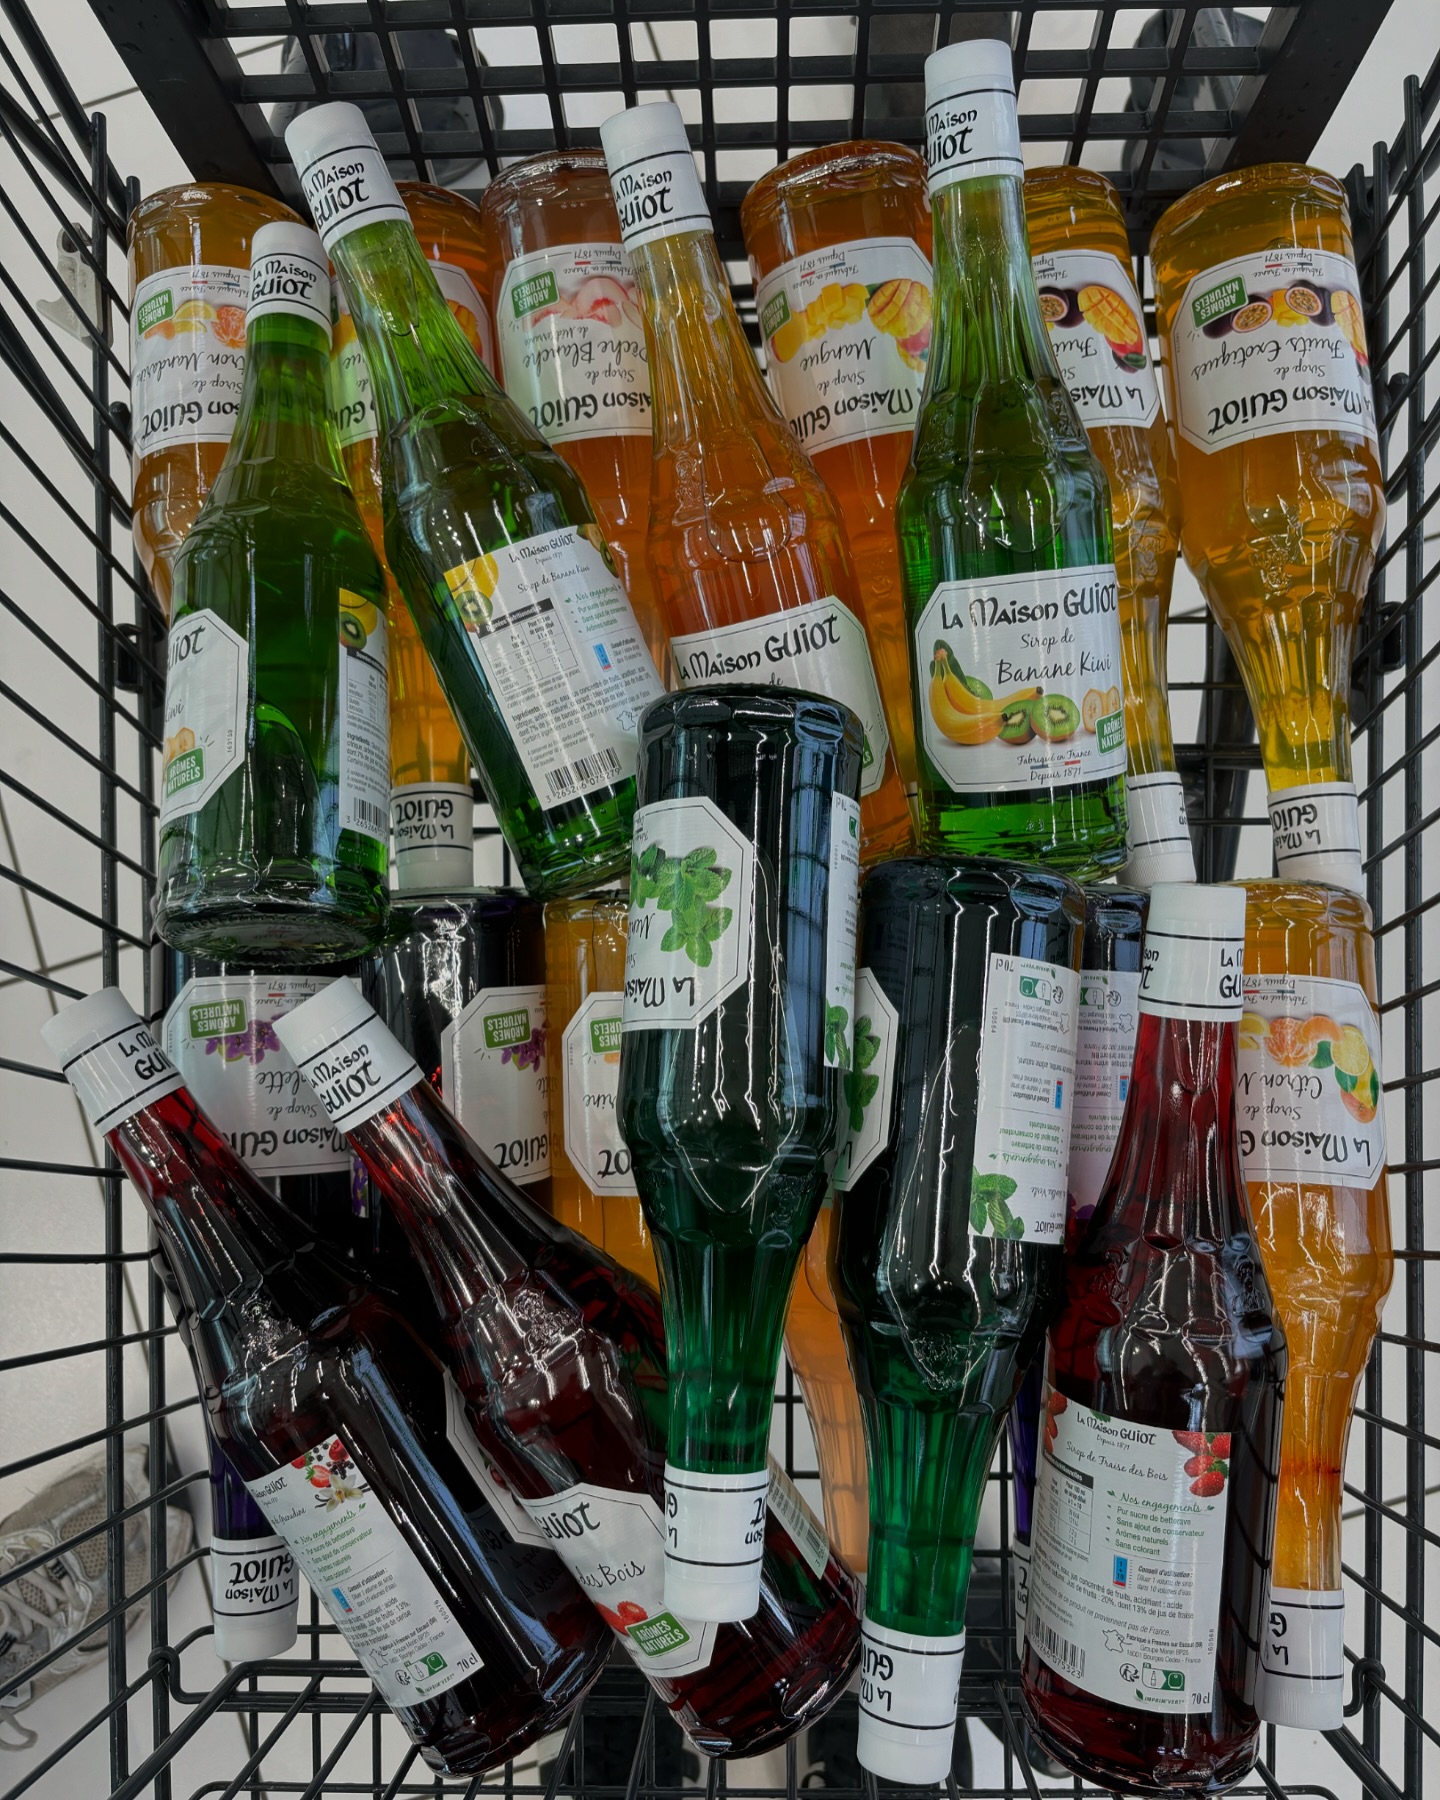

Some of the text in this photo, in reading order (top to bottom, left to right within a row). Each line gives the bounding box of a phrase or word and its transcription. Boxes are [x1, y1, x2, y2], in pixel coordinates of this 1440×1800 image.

[312, 162, 364, 190] Maison
[620, 170, 672, 197] Maison
[574, 250, 592, 261] 1871
[1265, 249, 1315, 265] Depuis 1871
[253, 259, 317, 282] La Maison
[512, 274, 551, 302] NATURELS
[517, 289, 549, 312] ARÔMES
[1194, 281, 1241, 310] NATURELS
[1200, 294, 1238, 322] ARÔMES
[522, 340, 593, 378] Blanche
[799, 335, 877, 372] Mangue
[1191, 341, 1282, 382] Exotiques
[1286, 337, 1346, 361] Fruits
[584, 362, 635, 386] Sirop de
[1274, 357, 1327, 382] Sirop de
[191, 373, 244, 394] Sirop de
[816, 368, 866, 397] Sirop de
[603, 391, 651, 413] aison
[833, 387, 914, 417] Maison
[1125, 386, 1145, 412] La
[1293, 386, 1363, 416] Maison
[519, 541, 551, 560] Maison
[941, 601, 964, 631] La
[968, 596, 1059, 628] Maison
[1019, 627, 1076, 656] Sirop de
[675, 655, 691, 682] La
[689, 650, 762, 680] Maison
[995, 649, 1112, 687] Banane Kiwi
[440, 823, 454, 841] La
[1304, 828, 1321, 847] La
[995, 956, 1014, 972] 70 cl
[1220, 947, 1234, 968] La
[672, 976, 695, 1008] La
[192, 1002, 241, 1023] NATURELS
[198, 1015, 237, 1033] ARÔMES
[486, 1012, 528, 1031] NATURELS
[493, 1025, 525, 1043] ARÔMES
[118, 1042, 140, 1059] La
[313, 1044, 370, 1083] Maison
[1260, 1073, 1324, 1101] Citron
[266, 1097, 318, 1122] Sirop de
[1243, 1096, 1304, 1122] Sirop de
[282, 1128, 350, 1153] Maison
[1261, 1128, 1349, 1164] Maison
[1353, 1136, 1371, 1168] La
[1076, 1411, 1085, 1426] La
[1086, 1415, 1119, 1438] Maison
[1065, 1441, 1086, 1462] Sirop
[1086, 1448, 1097, 1463] de
[1098, 1454, 1127, 1473] Fraise
[1127, 1462, 1146, 1478] des
[1146, 1466, 1169, 1482] Bois
[1120, 1492, 1202, 1514] Nos engagements
[298, 1507, 359, 1544] Nos engagements
[1116, 1516, 1205, 1538] Sans ajout de conservateur
[1117, 1506, 1192, 1526] Pur sucre de betterave
[336, 1526, 375, 1553] conservateur
[1115, 1527, 1169, 1547] Arômes naturels
[1115, 1538, 1161, 1556] Sans colorant
[599, 1560, 646, 1587] Bois
[1137, 1565, 1159, 1576] Conseil
[224, 1577, 294, 1605] La Maison
[1117, 1598, 1132, 1611] dont
[1132, 1603, 1148, 1616] 13%
[1148, 1607, 1157, 1616] de
[1156, 1608, 1168, 1620] jus
[1168, 1609, 1177, 1618] de
[1166, 1600, 1183, 1610] acide
[635, 1619, 672, 1641] ARÔMES
[640, 1628, 685, 1655] NATURELS
[1128, 1621, 1140, 1634] pas
[1140, 1623, 1149, 1633] de
[1149, 1625, 1171, 1638] France.
[456, 1651, 478, 1672] 70 cl
[1271, 1642, 1289, 1667] La
[876, 1686, 893, 1713] La
[1191, 1692, 1211, 1706] 70 cl
